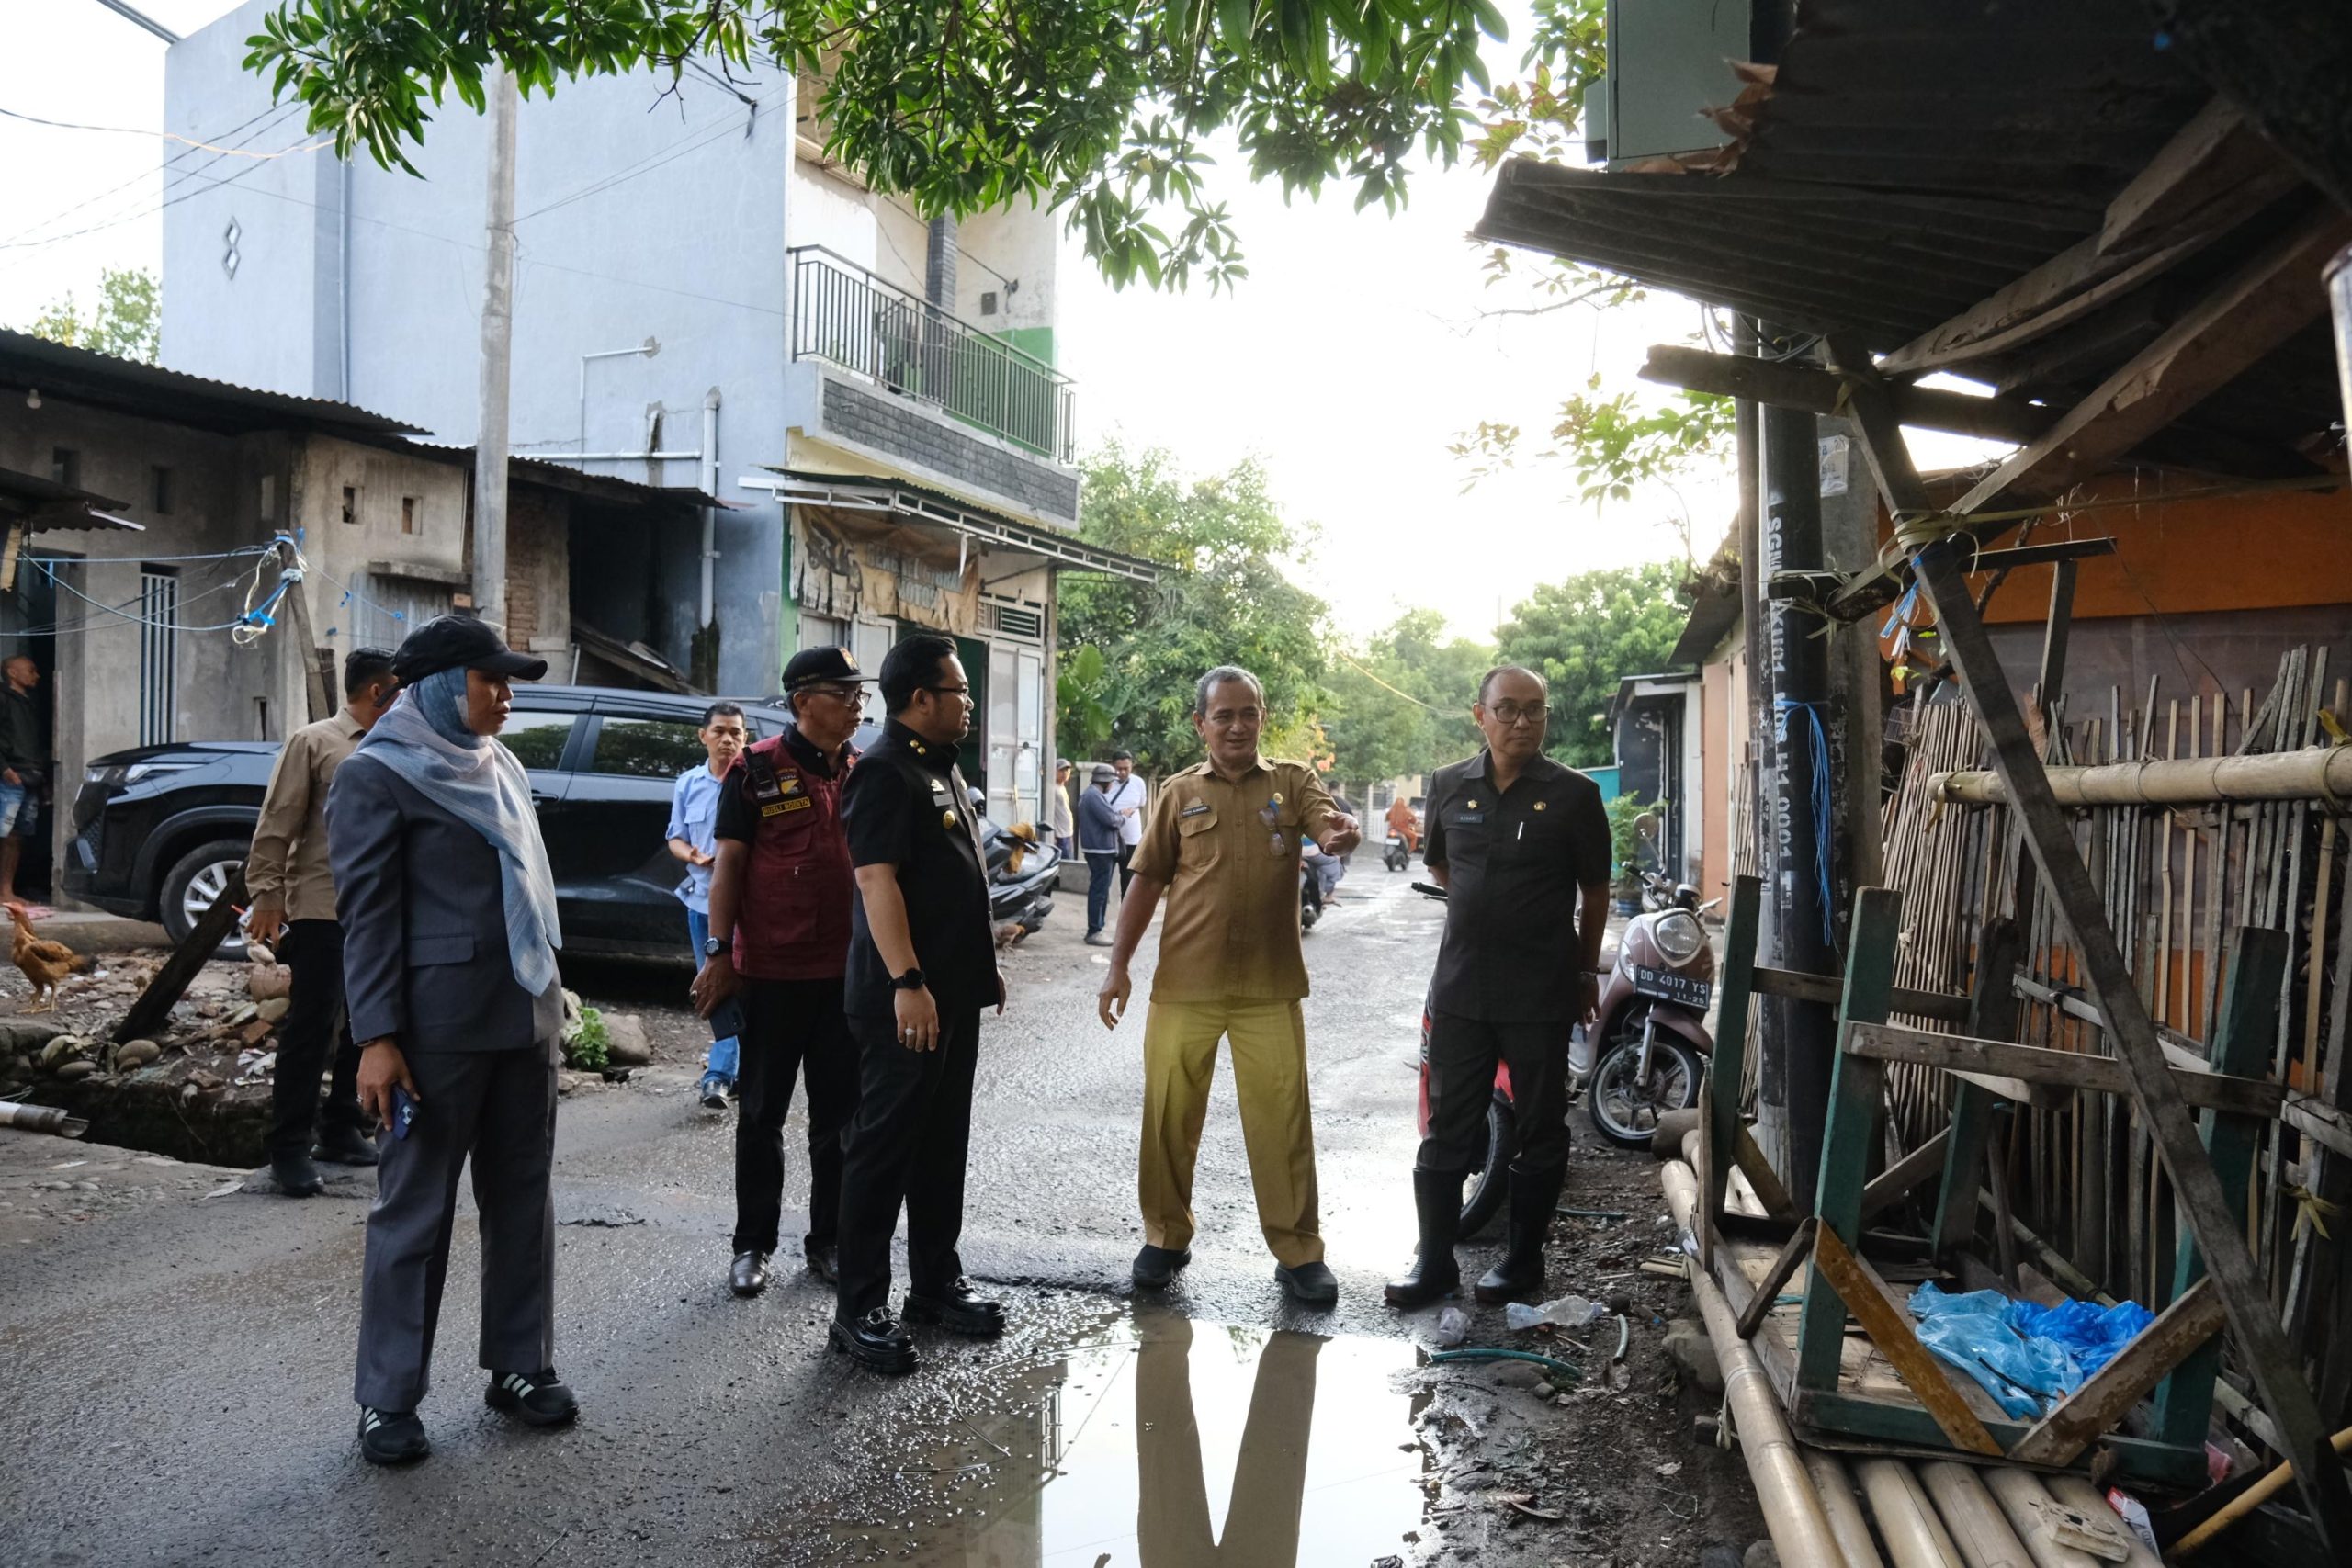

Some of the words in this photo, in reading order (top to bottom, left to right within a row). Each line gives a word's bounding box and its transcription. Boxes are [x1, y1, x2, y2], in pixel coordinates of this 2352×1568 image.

[1640, 969, 1654, 982] DD
[1659, 974, 1687, 989] 4017
[1692, 981, 1706, 995] YS
